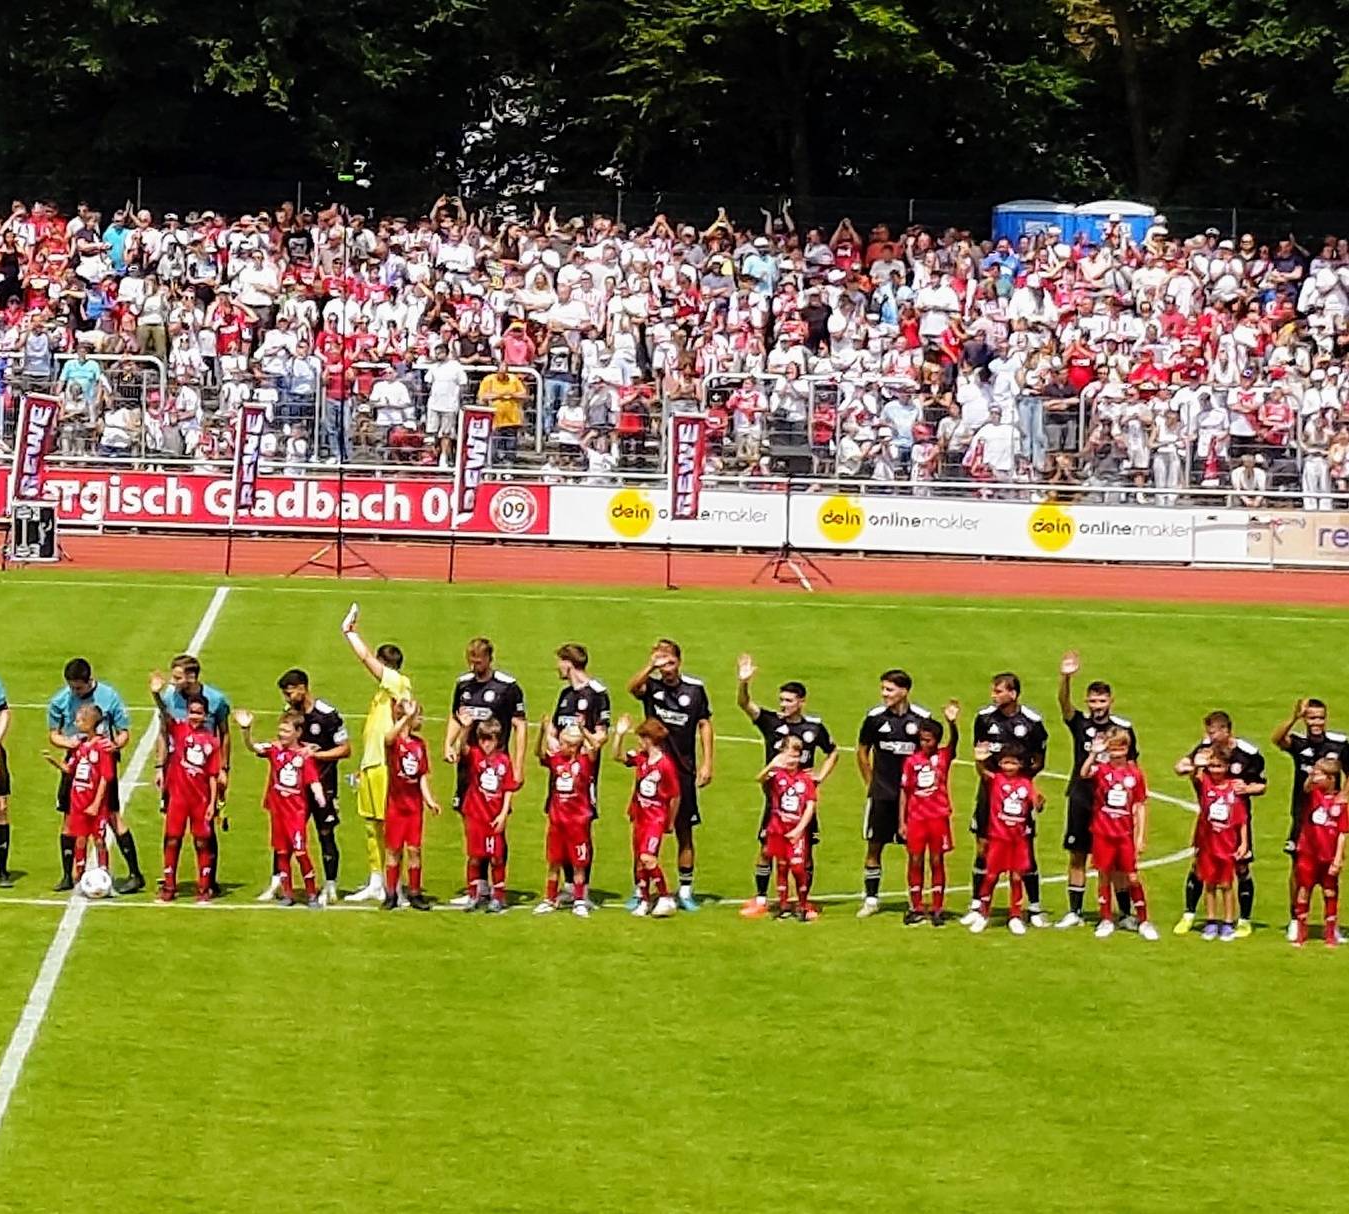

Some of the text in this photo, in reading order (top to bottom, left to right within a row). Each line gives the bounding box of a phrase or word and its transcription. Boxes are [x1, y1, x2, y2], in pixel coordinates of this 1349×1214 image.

[8, 474, 192, 522] ergisch
[203, 479, 411, 523] Gadbach
[502, 501, 525, 519] 09
[611, 504, 650, 520] dein
[658, 506, 768, 523] oemakler
[822, 509, 860, 526] dein
[868, 512, 981, 530] onlinemakler
[1032, 518, 1071, 536] dein
[1079, 520, 1191, 538] onlinemakler
